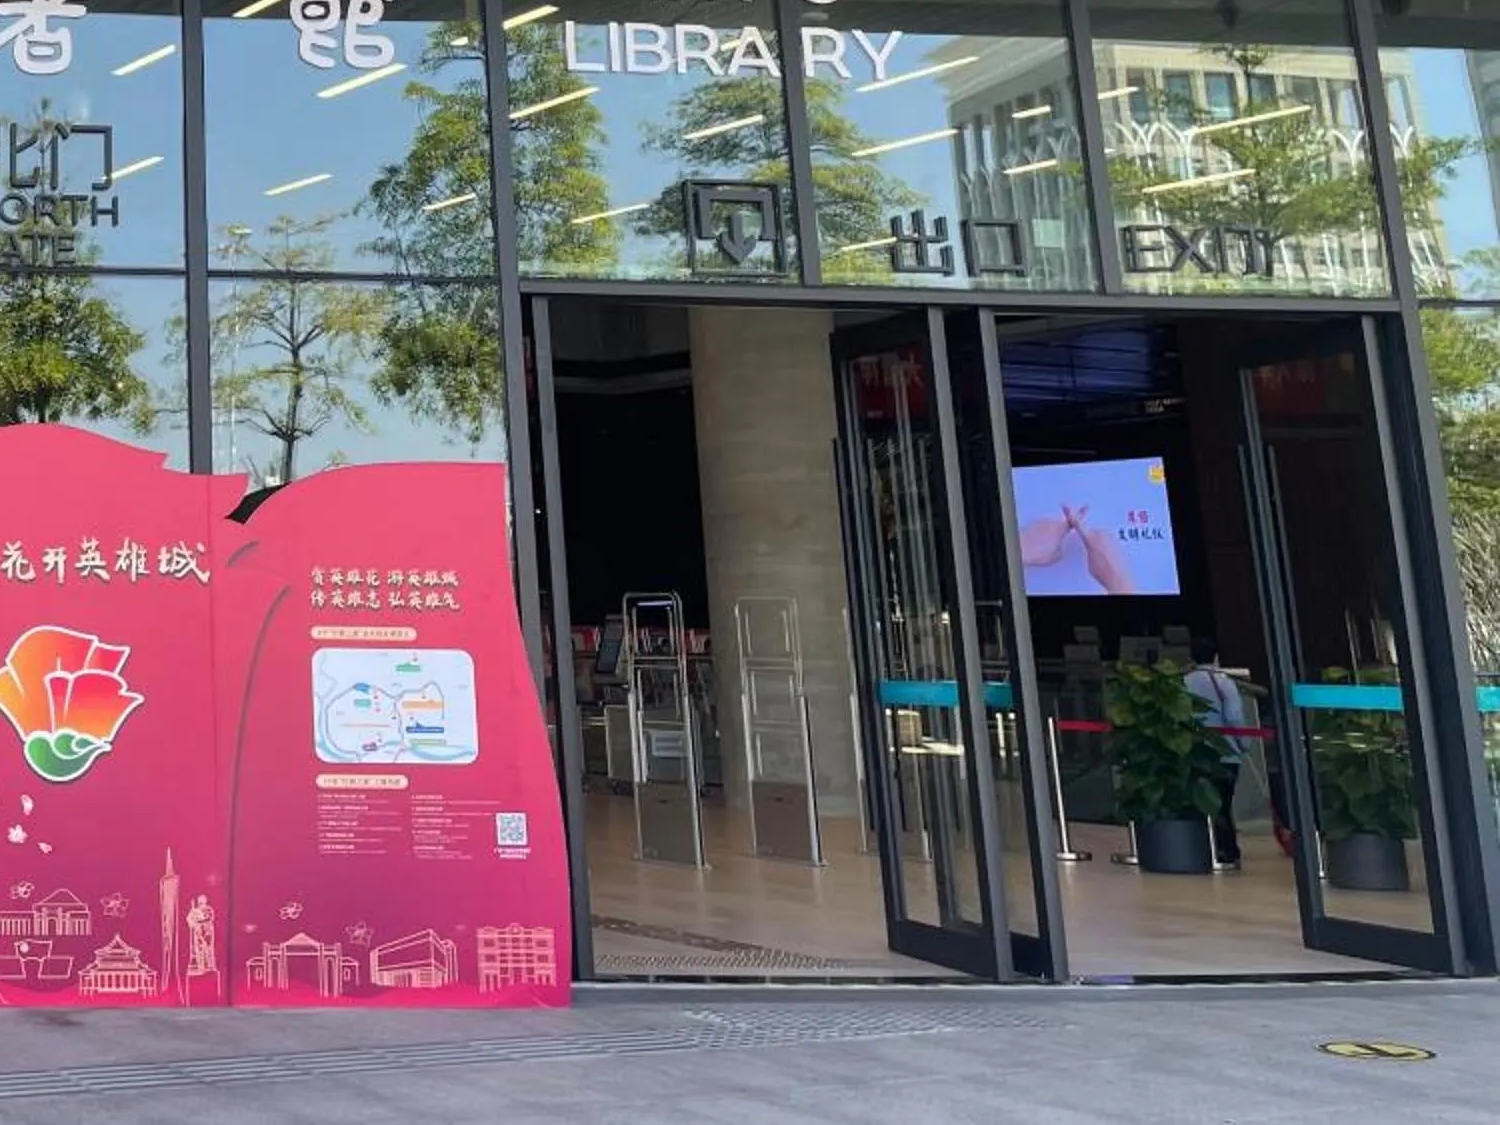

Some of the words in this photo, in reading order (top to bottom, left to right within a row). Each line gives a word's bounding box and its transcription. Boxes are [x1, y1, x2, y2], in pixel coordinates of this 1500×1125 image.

[564, 20, 903, 81] LIBRARY
[890, 209, 1026, 276] 出口
[1122, 223, 1272, 275] EXIT
